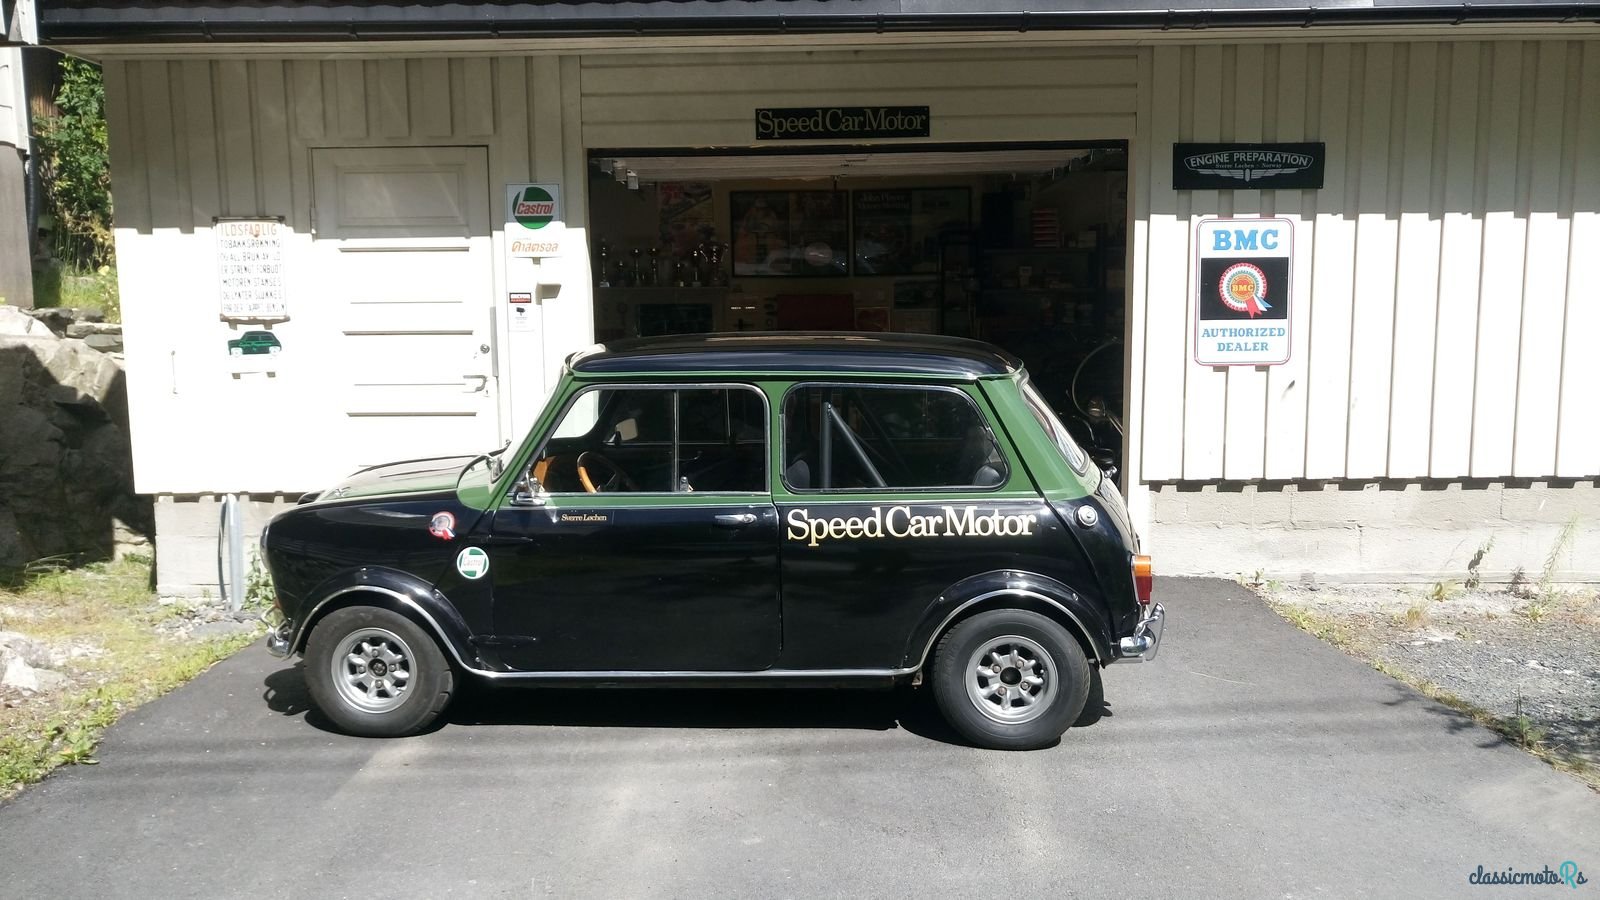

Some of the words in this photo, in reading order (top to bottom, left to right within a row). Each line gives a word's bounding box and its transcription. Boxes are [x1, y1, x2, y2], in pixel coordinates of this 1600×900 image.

[1190, 153, 1230, 167] ENGINE
[1233, 152, 1309, 166] PREPARATION
[516, 202, 554, 215] Castrol
[1212, 229, 1279, 251] BMC
[1231, 284, 1254, 292] BMC
[1201, 327, 1286, 339] AUTHORIZED
[1217, 341, 1269, 352] DEALER
[561, 513, 583, 522] Sverre
